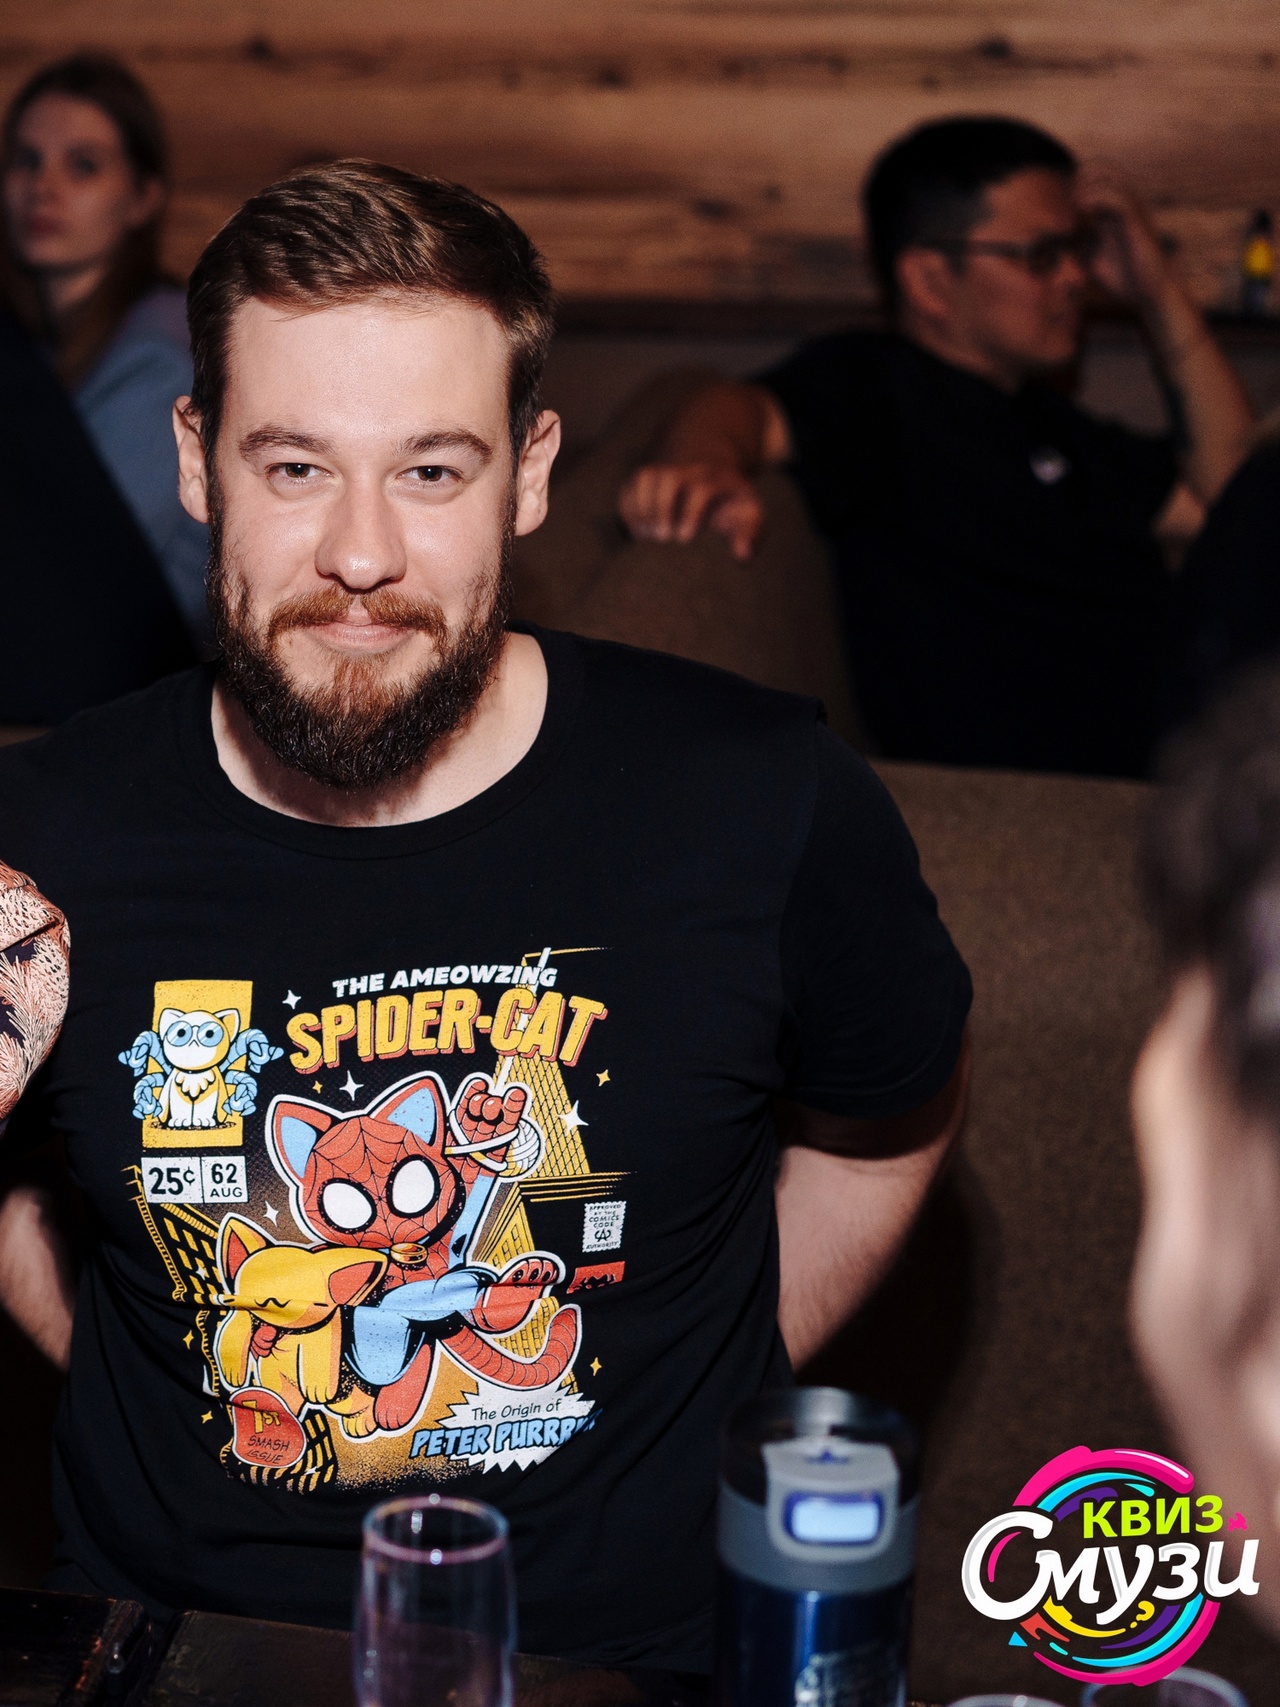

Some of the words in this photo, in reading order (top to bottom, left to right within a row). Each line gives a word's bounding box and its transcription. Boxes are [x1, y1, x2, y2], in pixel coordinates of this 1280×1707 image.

[331, 972, 385, 998] THE
[390, 964, 558, 990] AMEOWZING
[285, 987, 609, 1075] SPIDER-CAT
[148, 1166, 196, 1195] 25¢
[211, 1163, 237, 1184] 62
[210, 1187, 243, 1198] AUG
[588, 1215, 619, 1223] COMICS
[471, 1407, 497, 1421] The
[500, 1402, 541, 1419] Origin
[545, 1398, 563, 1412] of
[247, 1434, 290, 1452] SMASH
[409, 1424, 492, 1459] PETER
[246, 1449, 284, 1464] ISSUE
